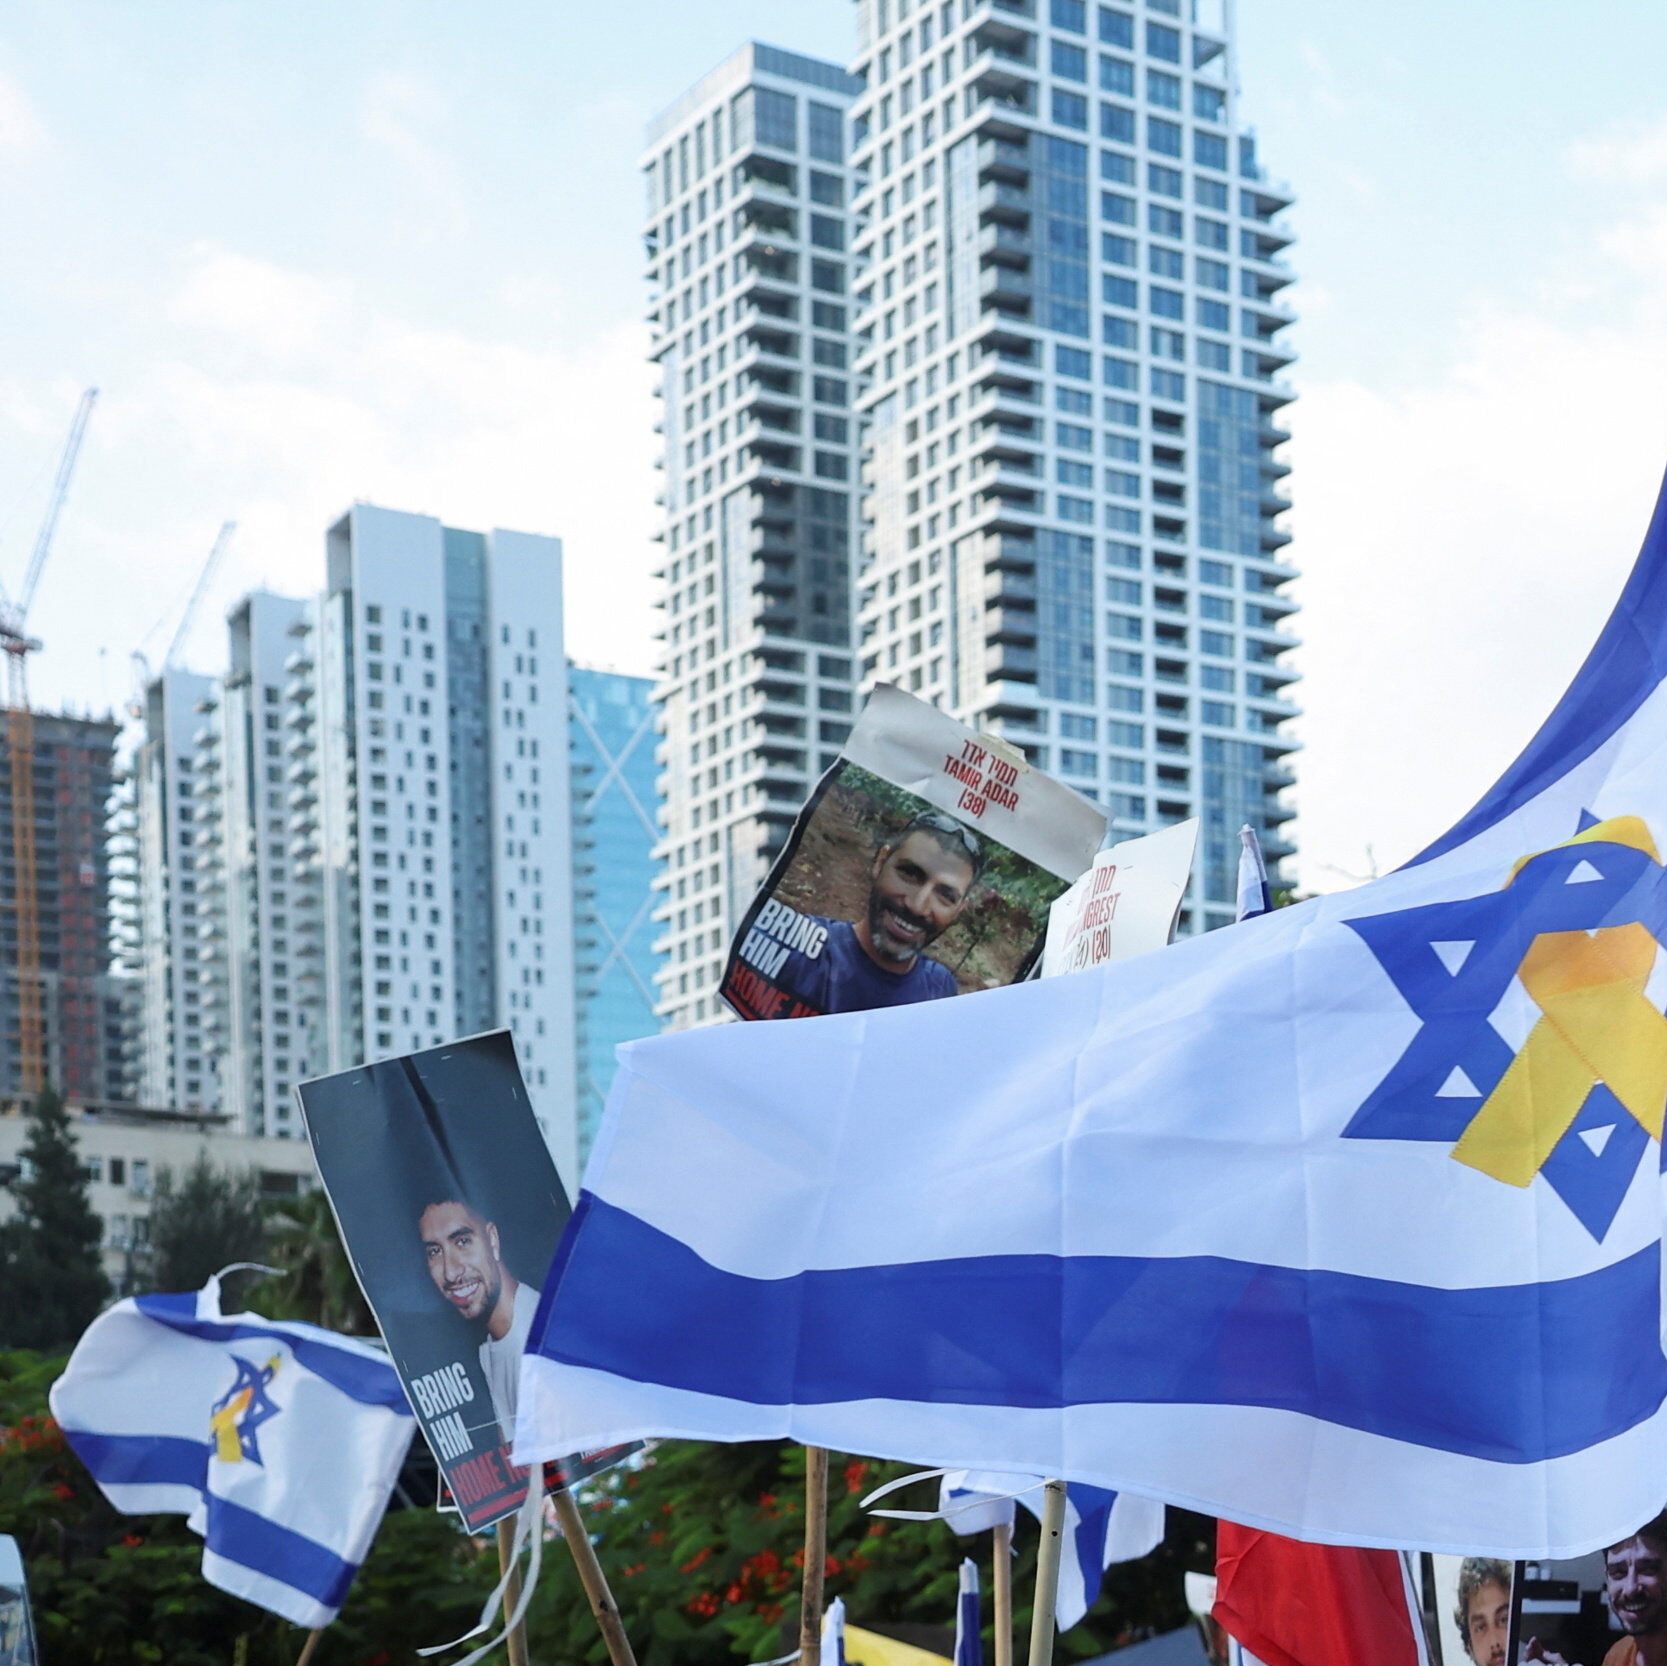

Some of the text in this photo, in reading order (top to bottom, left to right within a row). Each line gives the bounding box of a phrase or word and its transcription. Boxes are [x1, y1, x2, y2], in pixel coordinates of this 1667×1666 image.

[943, 754, 1019, 812] TAMIR ADAR
[961, 739, 1018, 787] תמיר אדר
[957, 788, 988, 819] (38)
[738, 928, 792, 980] HIM
[752, 897, 829, 960] BRING
[729, 960, 791, 1020] HOME
[410, 1362, 475, 1420] BRING
[429, 1410, 474, 1462] HIM
[450, 1450, 507, 1506] HOME
